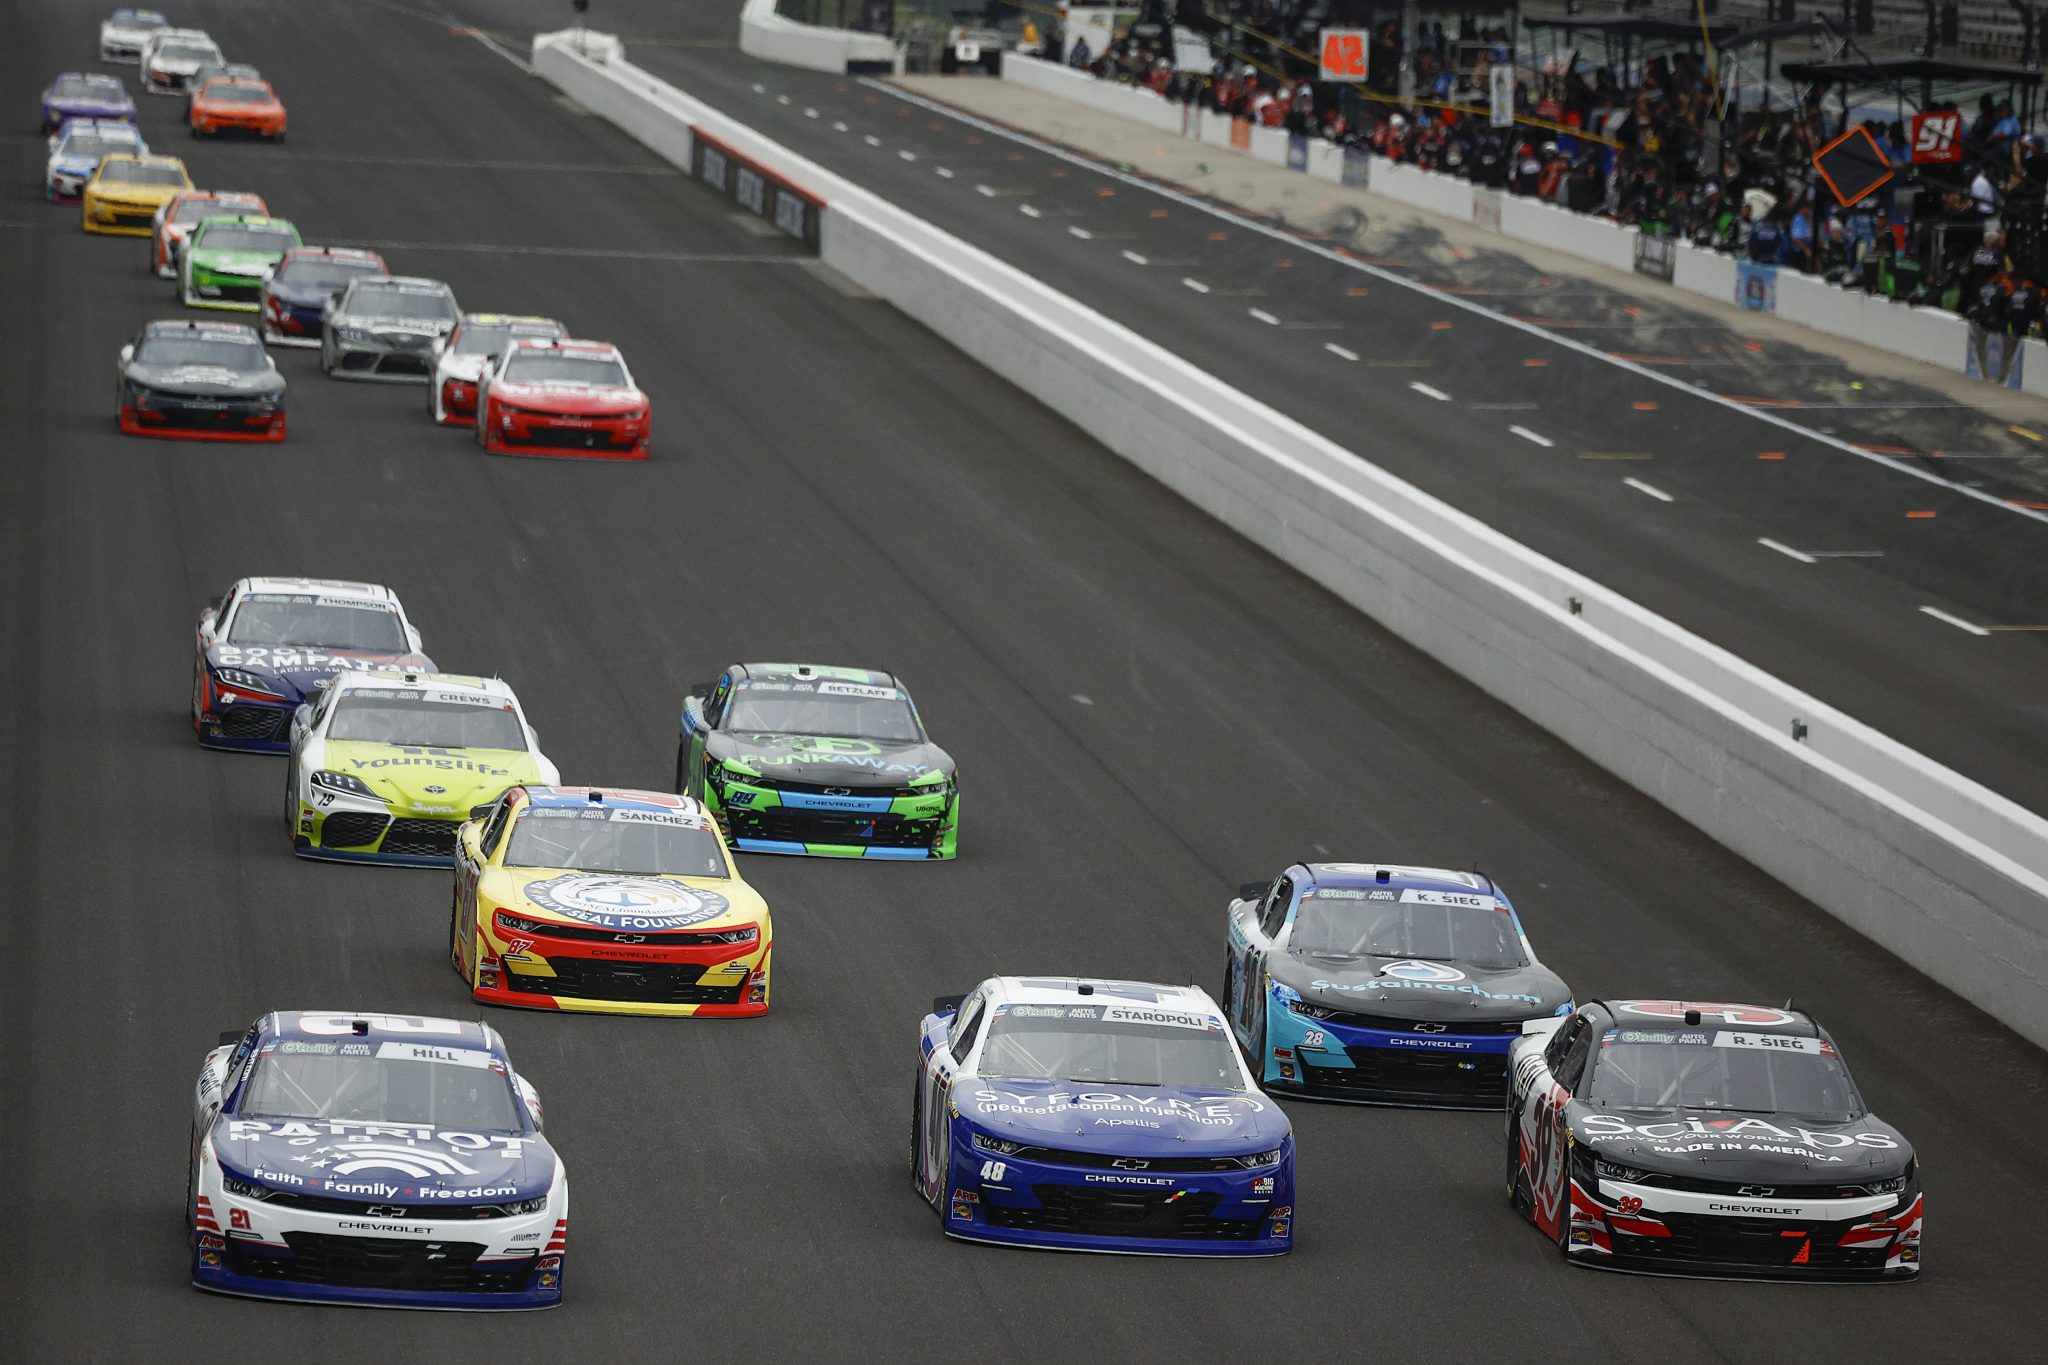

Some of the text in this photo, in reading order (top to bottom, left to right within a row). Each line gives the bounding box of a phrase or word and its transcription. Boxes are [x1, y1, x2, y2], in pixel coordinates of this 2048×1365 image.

[1322, 35, 1366, 75] 42
[323, 597, 387, 610] THOMPSON
[220, 691, 237, 705] 26
[828, 685, 888, 697] RETZLAFF
[440, 693, 491, 705] CREWS
[349, 757, 511, 778] younglife
[740, 753, 929, 774] FUNKAWAY
[318, 793, 335, 807] 19
[805, 799, 873, 809] CHEVROLET
[620, 811, 694, 827] SANCHEZ
[1319, 888, 1368, 900] O'Reilly
[1418, 894, 1480, 906] K. SIEG
[566, 909, 615, 927] SEAL
[620, 903, 728, 930] FOUNDATION
[506, 938, 536, 956] 87
[591, 949, 670, 960] CHEVROLET
[1311, 979, 1543, 1004] Sustainachem
[1011, 1005, 1066, 1019] O'Reilly
[1112, 1009, 1204, 1028] STAROPOLI
[1303, 1030, 1325, 1047] 28
[1390, 1038, 1473, 1049] CHEVROLET
[1620, 1031, 1676, 1044] O'Reilly
[1733, 1036, 1805, 1050] R. SIEG
[413, 1048, 459, 1062] HILL
[975, 1089, 1233, 1118] SYFOVRE
[976, 1101, 1139, 1116] (pegcetacoplan
[1138, 1104, 1235, 1127] injection)
[1094, 1117, 1161, 1129] Apellis
[229, 1120, 535, 1150] PATRIOT
[1582, 1114, 1899, 1151] SciAps
[1589, 1133, 1790, 1144] ANALYZE YOUR WORLD
[1653, 1143, 1844, 1162] MADE IN AMERICA
[980, 1160, 1007, 1182] 48
[253, 1168, 518, 1199] Faith Family Freedom
[1085, 1174, 1176, 1186] CHEVROLET
[1263, 1177, 1274, 1185] BIG
[954, 1190, 979, 1202] ARP
[1618, 1195, 1643, 1215] 39
[1709, 1203, 1803, 1215] CHEVROLET
[229, 1207, 252, 1231] 21
[338, 1220, 435, 1235] CHEVROLET
